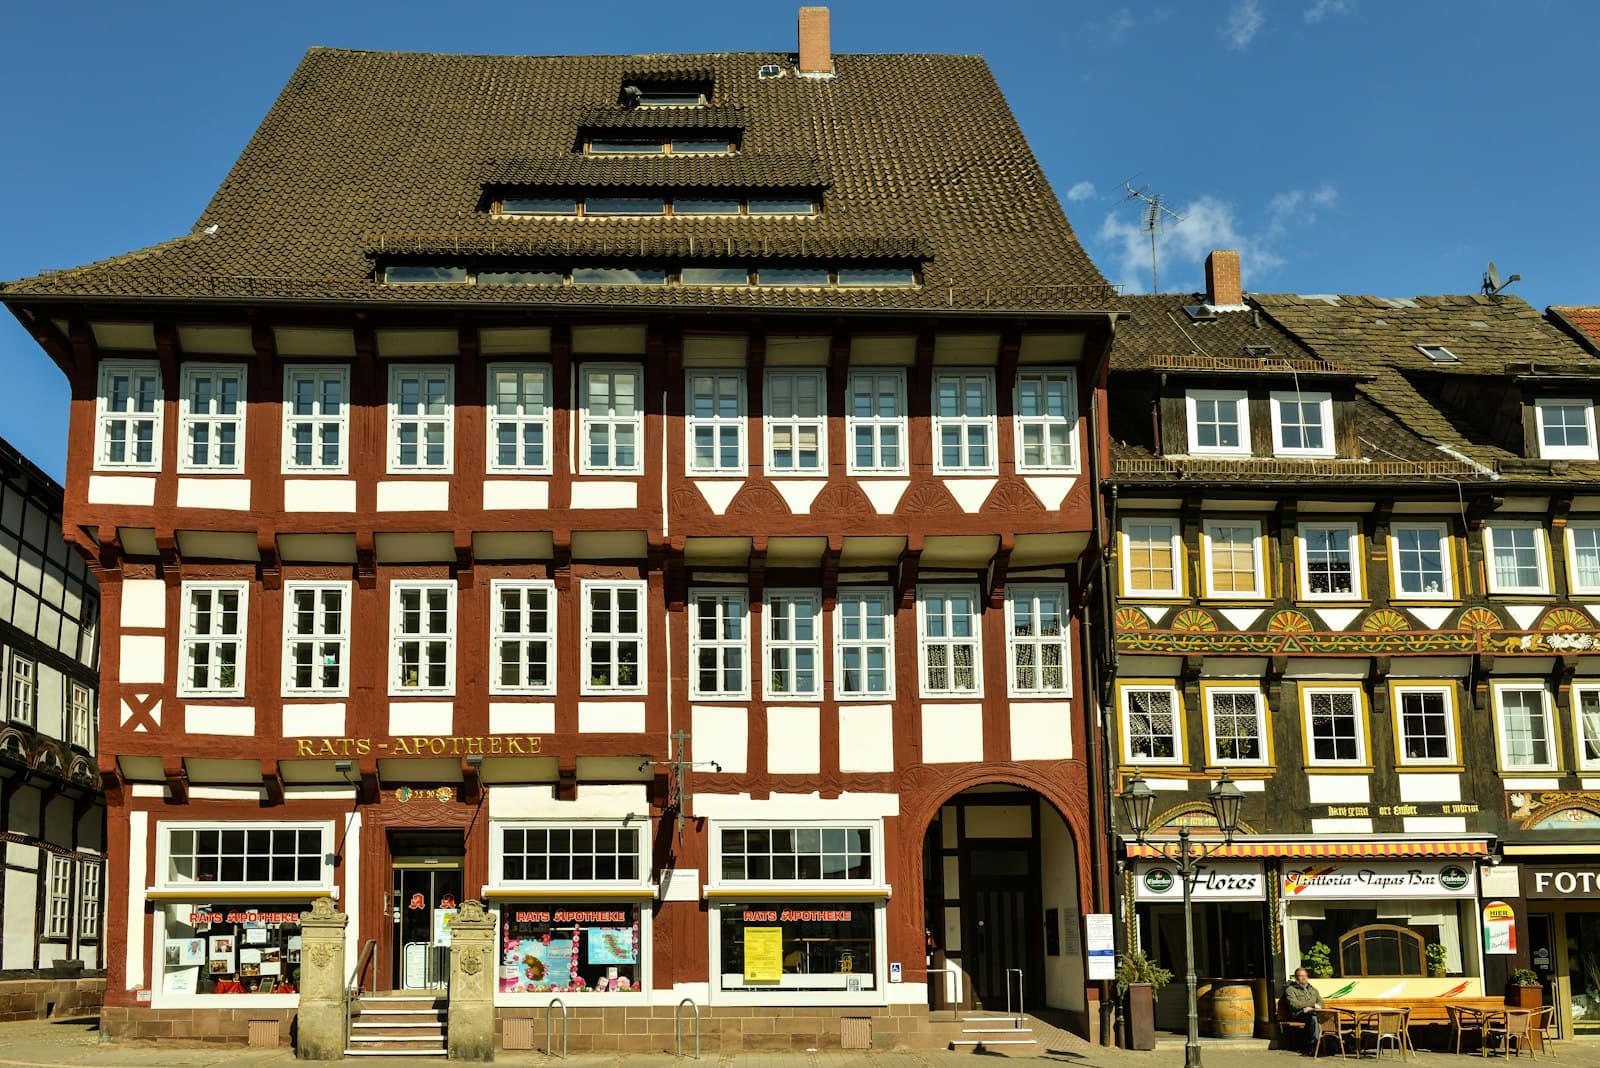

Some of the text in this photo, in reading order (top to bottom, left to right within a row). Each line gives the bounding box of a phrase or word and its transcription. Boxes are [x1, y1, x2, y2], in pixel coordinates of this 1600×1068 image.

[296, 738, 371, 756] RATS
[389, 736, 542, 755] APOTHEKE
[1189, 864, 1256, 894] Flores
[1286, 869, 1436, 889] Trattoria Tapas Bar
[1534, 871, 1600, 893] FOT
[189, 911, 299, 924] RATS APOTHEKE
[516, 910, 625, 922] RATS APOTHEKE
[743, 909, 851, 922] RATS APOTHEKE
